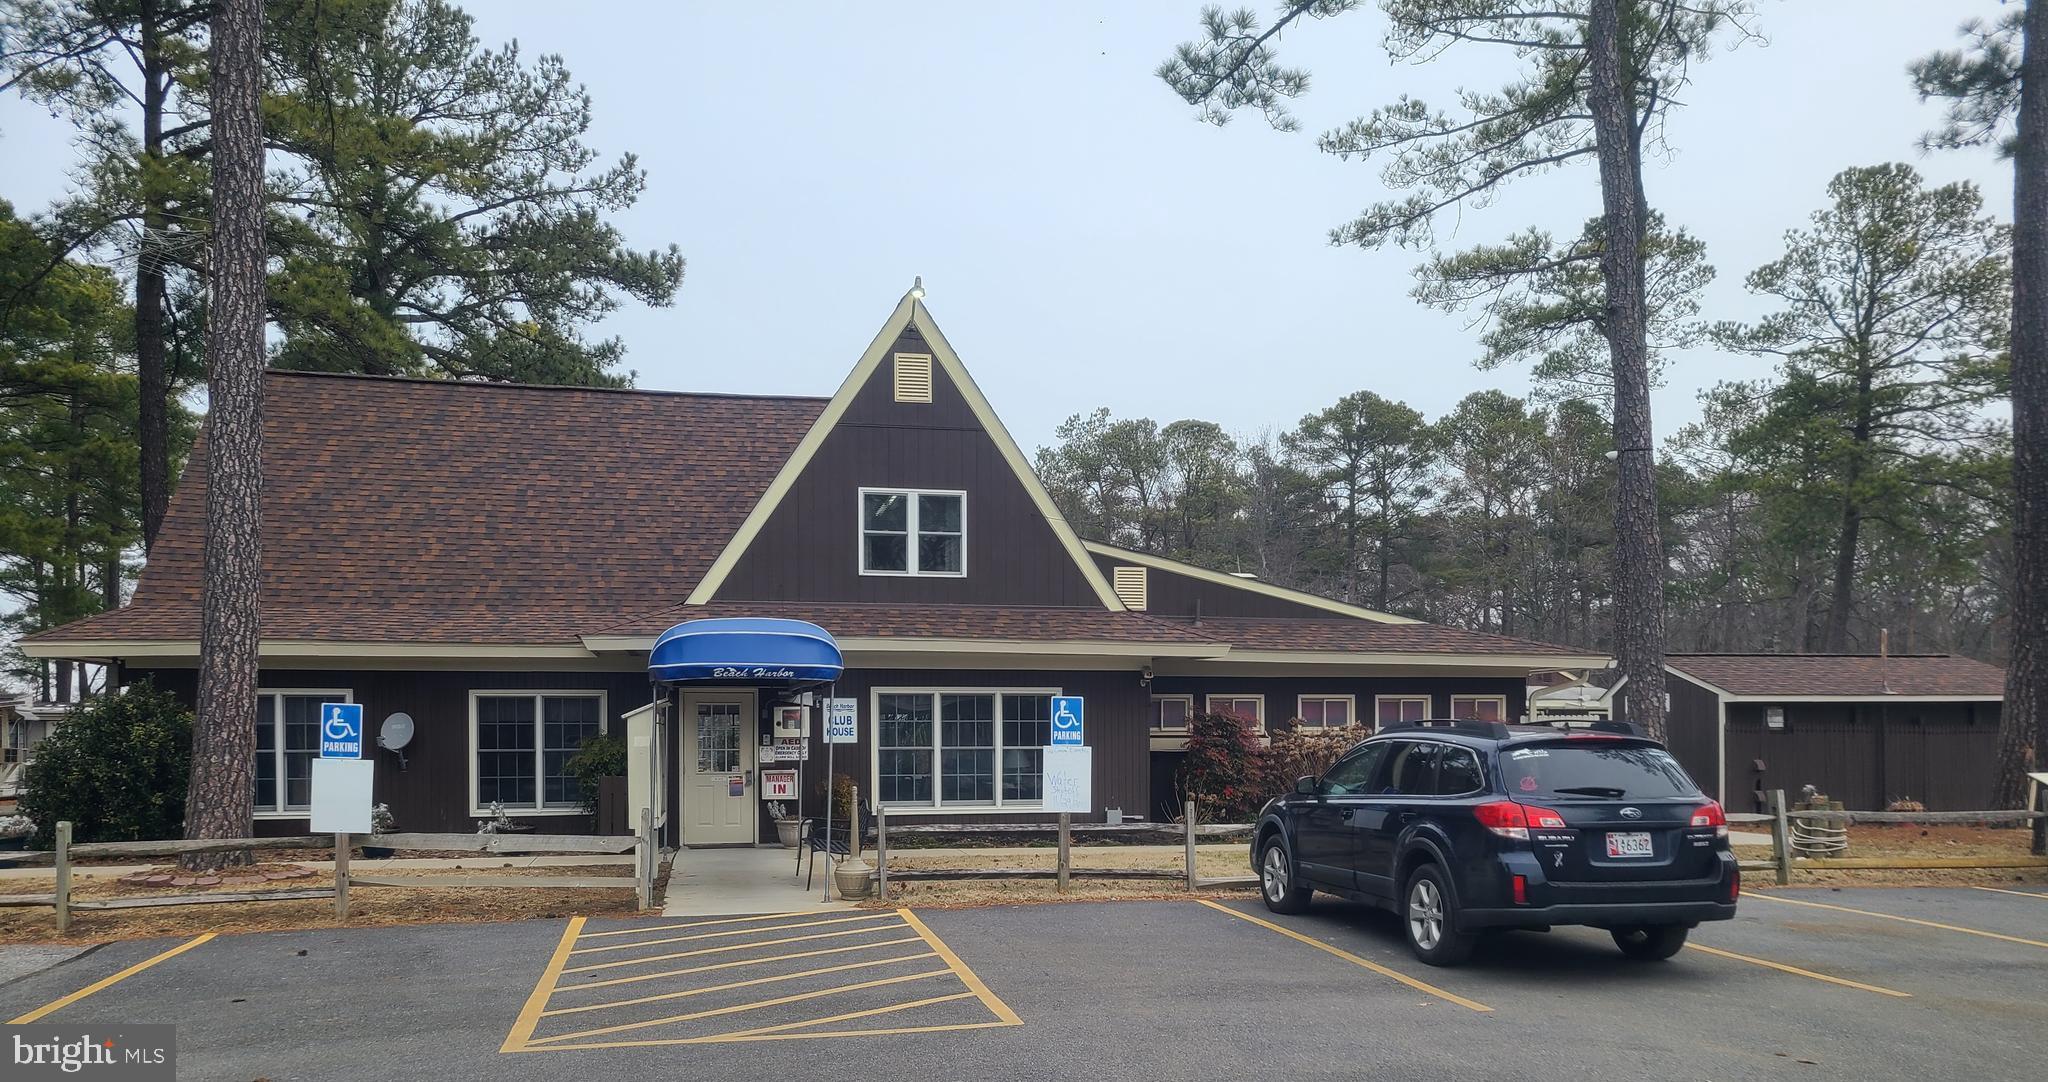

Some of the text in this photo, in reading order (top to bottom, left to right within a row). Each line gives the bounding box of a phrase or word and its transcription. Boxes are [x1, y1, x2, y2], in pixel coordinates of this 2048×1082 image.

[713, 667, 794, 677] Beach Harbor
[826, 727, 855, 737] HOUSE
[1054, 731, 1081, 740] PARKING
[324, 741, 358, 752] PARKING
[766, 775, 794, 783] MANAGER
[773, 783, 787, 794] IN
